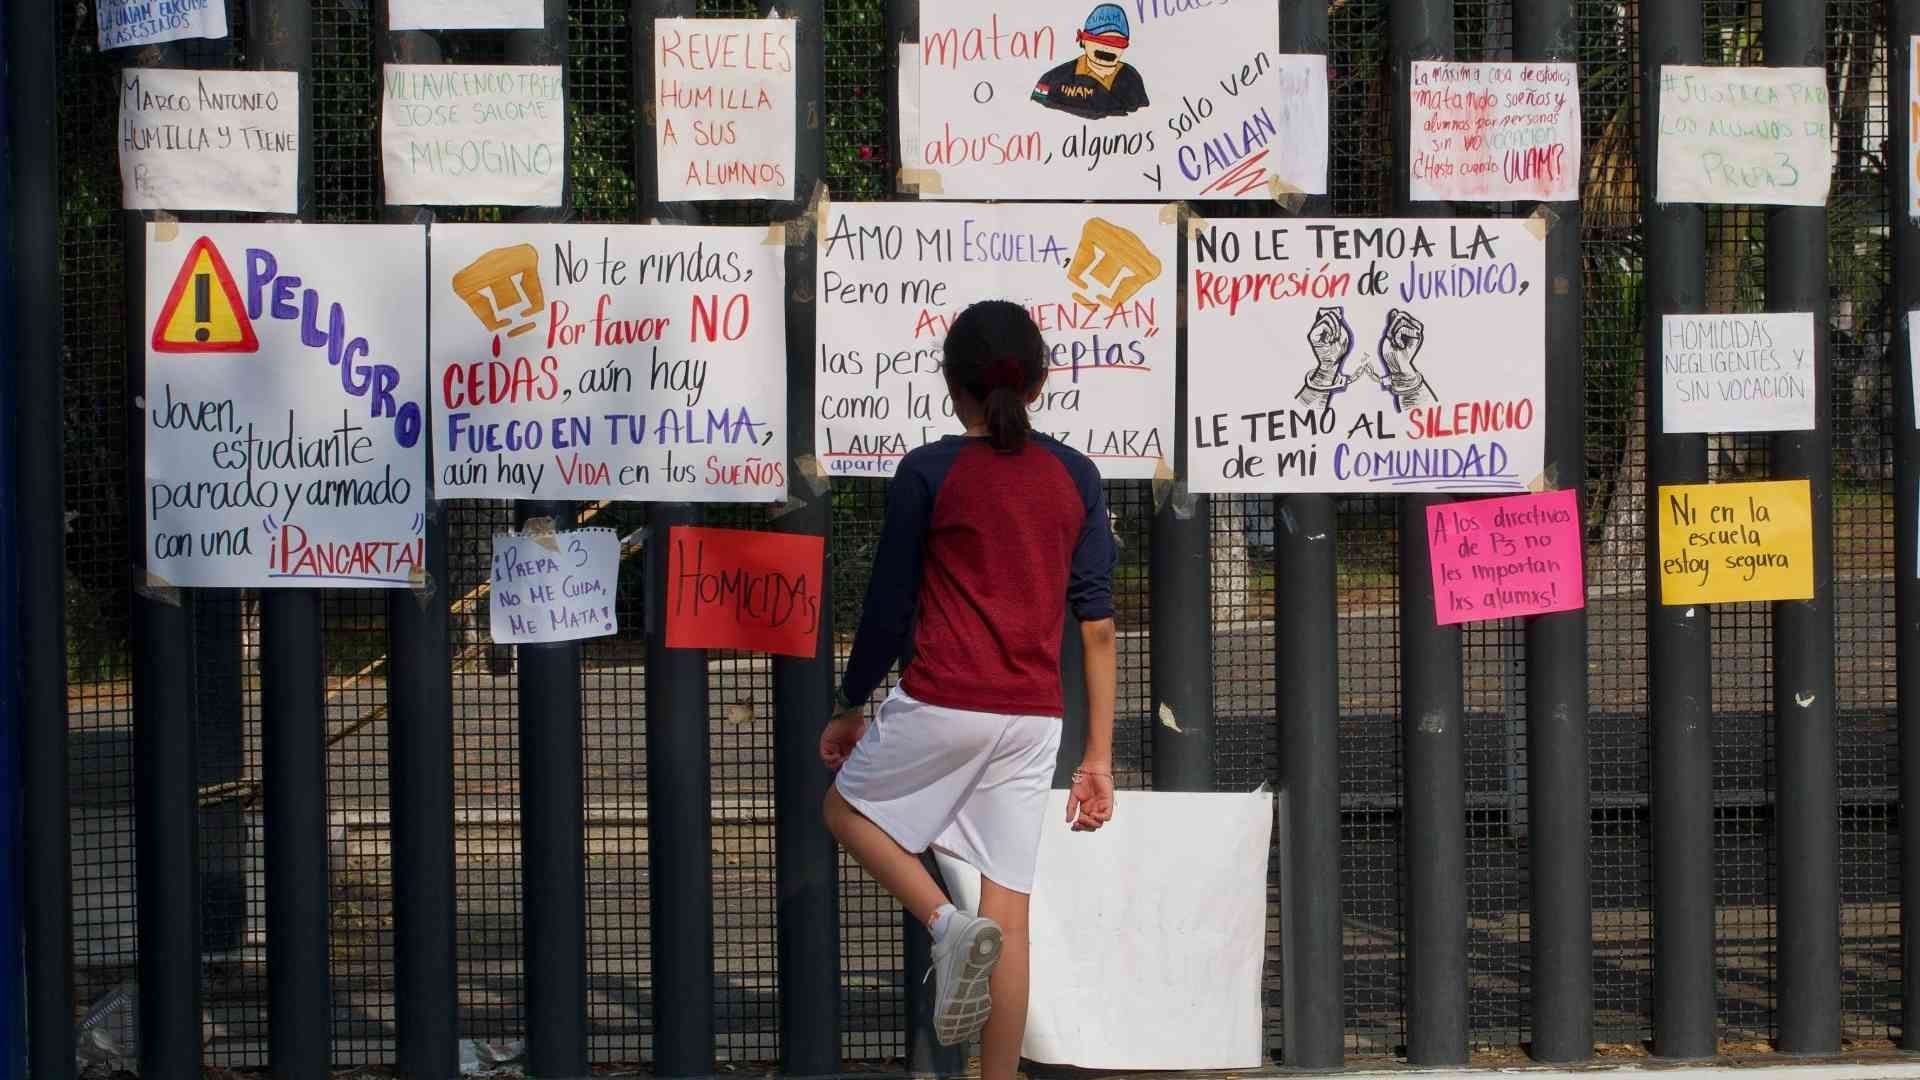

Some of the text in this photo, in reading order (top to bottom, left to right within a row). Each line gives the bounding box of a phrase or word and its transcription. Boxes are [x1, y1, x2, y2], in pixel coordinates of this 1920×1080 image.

[1091, 13, 1121, 23] UNAM
[661, 30, 791, 72] REVELES
[924, 14, 1056, 69] matan
[973, 81, 994, 103] o
[1220, 51, 1271, 97] ven
[1521, 66, 1534, 82] de
[123, 75, 278, 111] MARCO ANTONIO
[661, 79, 772, 110] HUMILLA
[1416, 86, 1566, 112] matando sueños y
[663, 119, 736, 146] A SUS
[1168, 96, 1213, 139] solo
[124, 120, 209, 151] HUMILLA
[240, 128, 296, 152] TIENE
[924, 122, 1154, 171] abusan, algunos
[1178, 107, 1277, 181] CALLAN
[1432, 138, 1452, 152] sin
[411, 140, 552, 176] MISOGINO
[686, 159, 785, 187] ALUMNOS
[1775, 153, 1799, 186] 3
[825, 214, 1071, 268] AMO MI ESCUELA,
[1196, 226, 1499, 263] NO LE TEMO A LA
[555, 237, 752, 286] No te rindas,
[824, 272, 947, 305] Pero me
[1196, 263, 1351, 316] Represión
[1357, 261, 1389, 295] de
[547, 294, 750, 349] Por favor NO
[1668, 320, 1773, 350] HOMICIDAS
[246, 248, 421, 449] PELIGRO
[822, 344, 863, 375] las
[1665, 348, 1806, 375] NEGLIGENTES Y
[443, 346, 708, 409] CEDAS, aún hay
[1676, 372, 1805, 401] SIN VOCACIÓN
[153, 384, 242, 434] Joven,
[821, 394, 889, 421] como
[908, 382, 931, 419] la
[213, 408, 374, 475] estudiante
[449, 406, 774, 452] FUEGO EN TU ALMA,
[1195, 399, 1533, 448] LE TEMO AL SILENCIO
[827, 428, 907, 455] LAURA
[1086, 428, 1163, 457] LARA
[444, 450, 785, 494] aún hay VIDA en tus SUEÑOS
[831, 456, 894, 475] aparte
[1223, 442, 1508, 481] de mi COMUNIDAD
[152, 465, 411, 522] parado y armado
[1711, 505, 1734, 523] en
[1749, 497, 1770, 523] la
[155, 528, 193, 559] con
[201, 527, 252, 557] una
[1434, 505, 1570, 546] A los directivos
[1689, 524, 1761, 546] escuela
[495, 539, 588, 582] ¡PREPA 3
[1458, 532, 1551, 558] de P3 no
[1441, 556, 1560, 586] les importan
[1664, 549, 1789, 587] estoy segura
[500, 591, 520, 608] NO
[530, 586, 554, 604] ME
[1450, 582, 1557, 611] lxs alumxs!
[510, 606, 612, 636] ME MATA!
